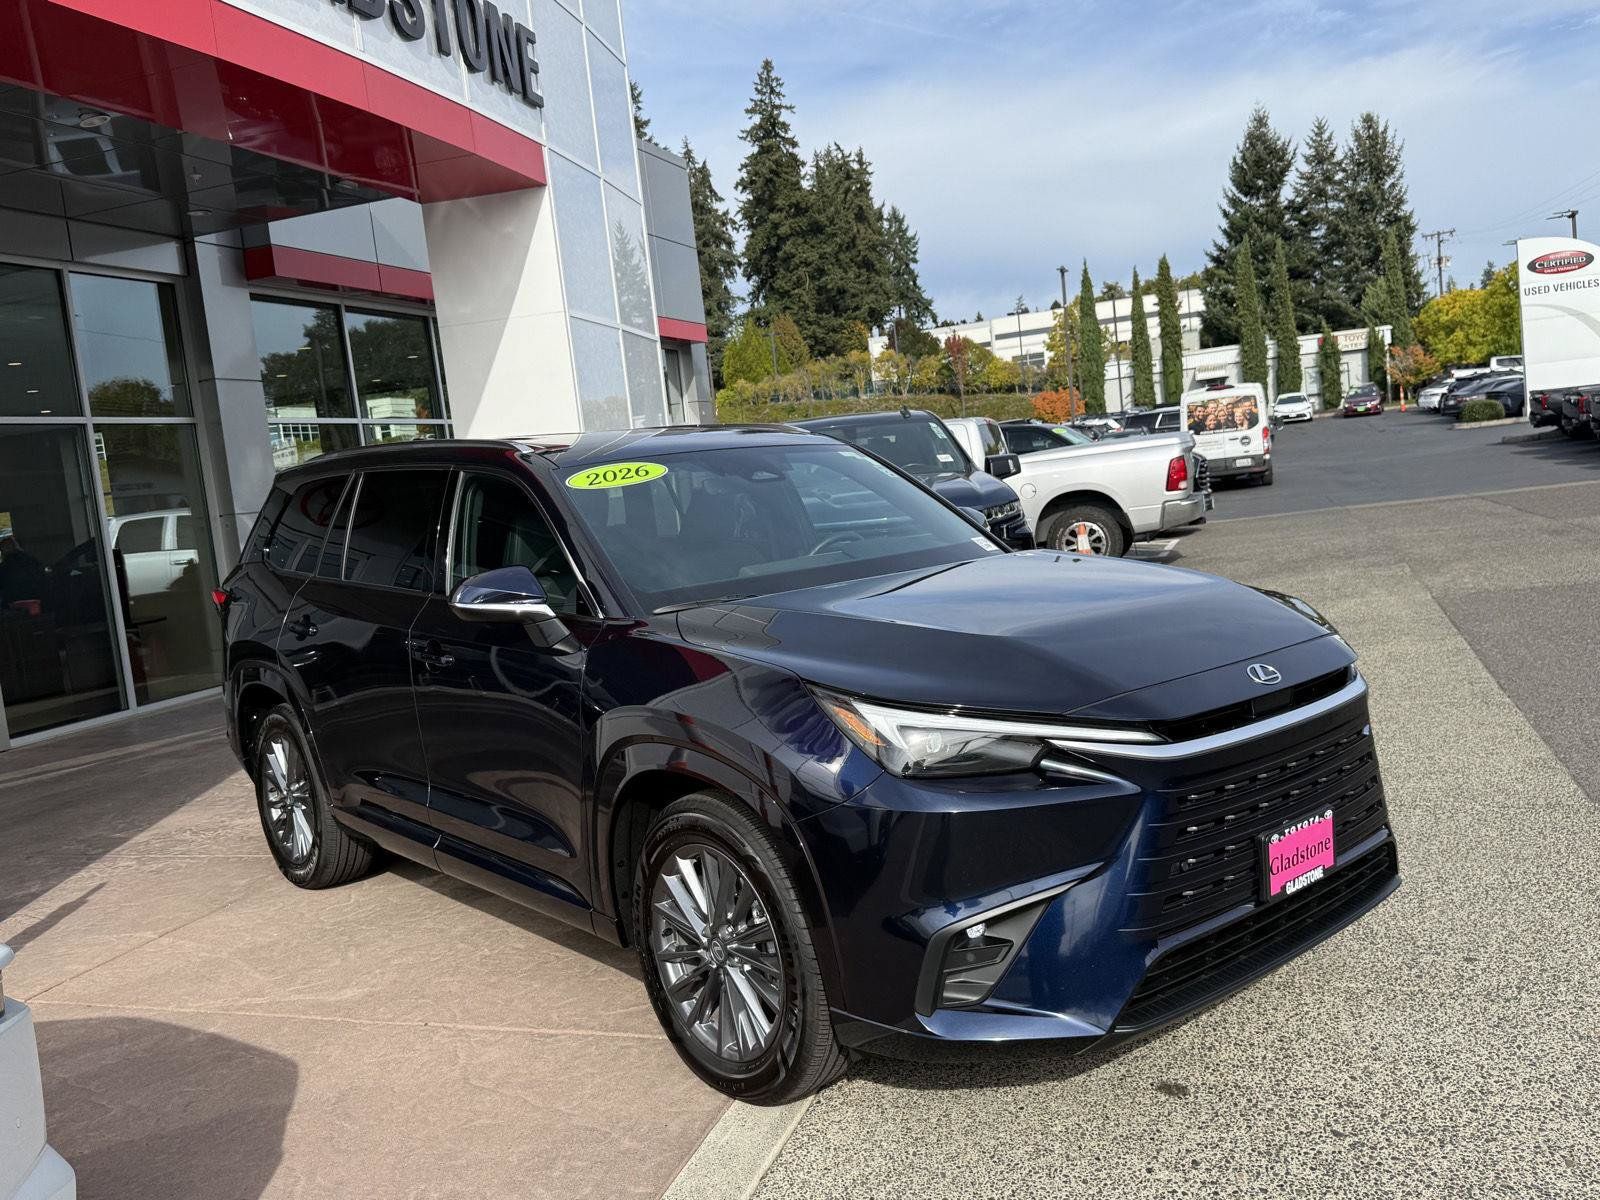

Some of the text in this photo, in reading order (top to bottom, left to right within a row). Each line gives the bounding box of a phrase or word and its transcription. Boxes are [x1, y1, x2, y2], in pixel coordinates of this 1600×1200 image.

[1535, 256, 1587, 269] CERTIFIED
[1524, 278, 1600, 297] USED VEHICLES
[586, 465, 650, 486] 2026
[1270, 837, 1331, 876] Gladstone
[1286, 865, 1324, 895] GLADSTONE
